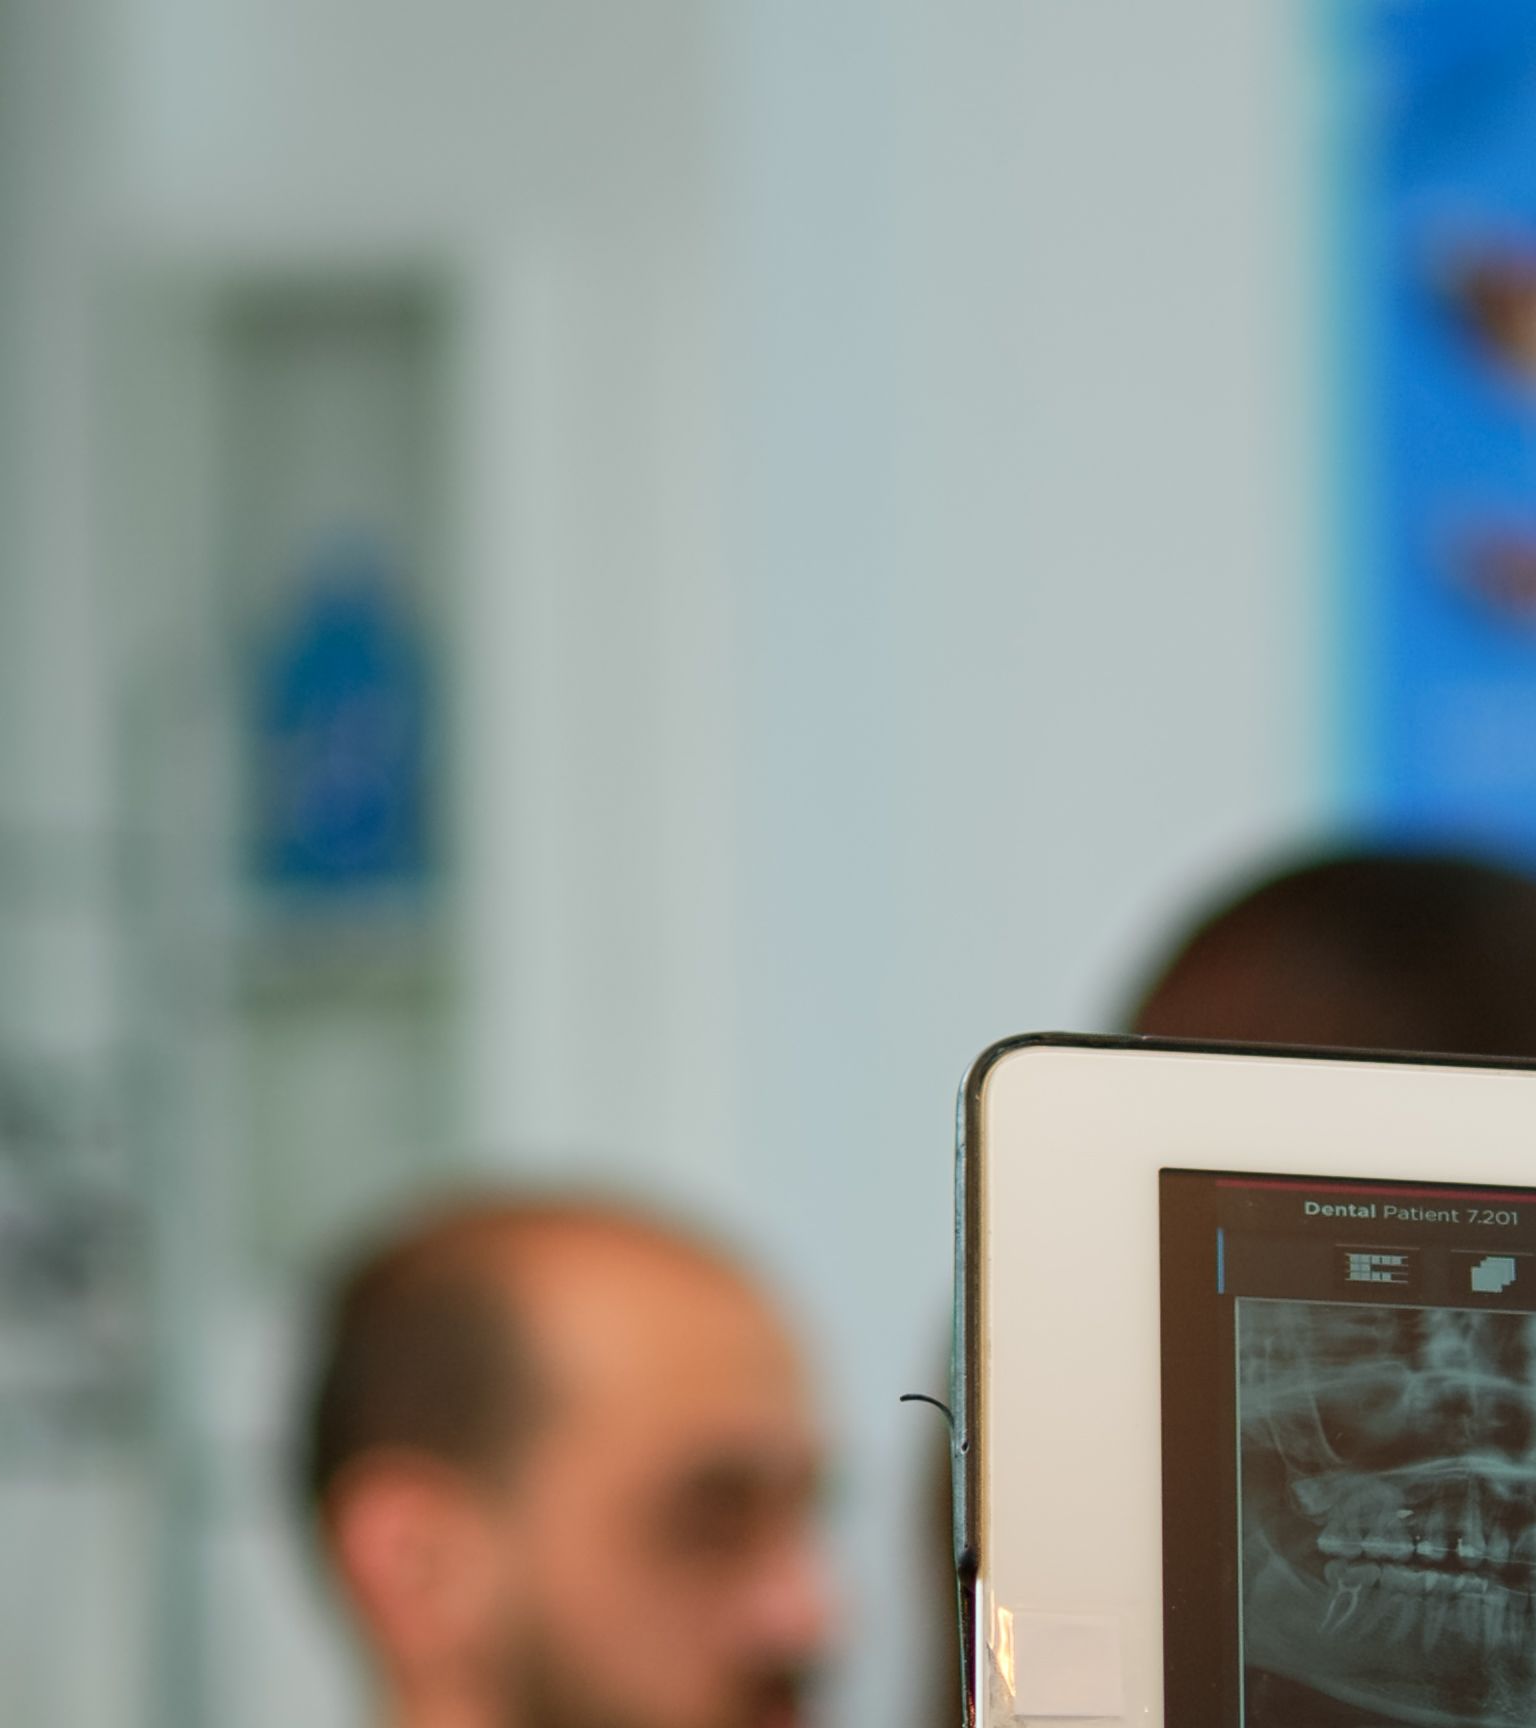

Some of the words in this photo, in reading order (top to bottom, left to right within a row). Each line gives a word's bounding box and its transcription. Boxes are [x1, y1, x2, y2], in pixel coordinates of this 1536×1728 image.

[1305, 1201, 1376, 1219] Dental
[1384, 1205, 1459, 1223] Patient
[1467, 1209, 1518, 1225] 7.201
